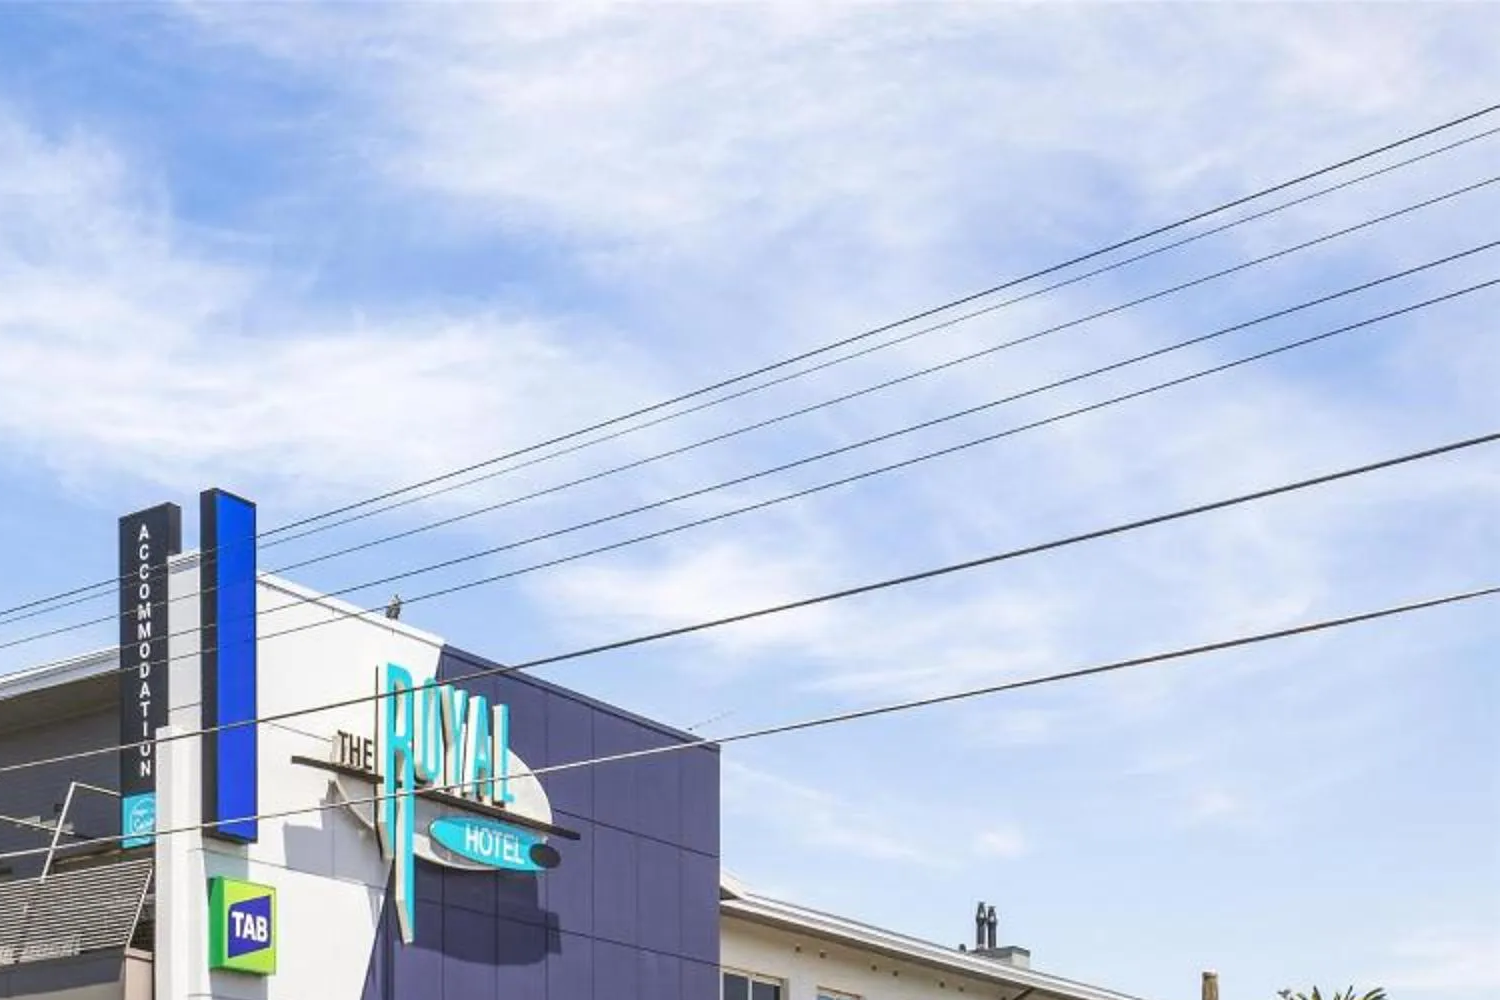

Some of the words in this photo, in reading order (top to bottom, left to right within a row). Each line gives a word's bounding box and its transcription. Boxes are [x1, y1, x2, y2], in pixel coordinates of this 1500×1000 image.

[137, 523, 151, 777] ACCOMMODATION
[337, 729, 373, 770] THE
[465, 822, 525, 865] HOTEL
[231, 910, 269, 942] TAB
